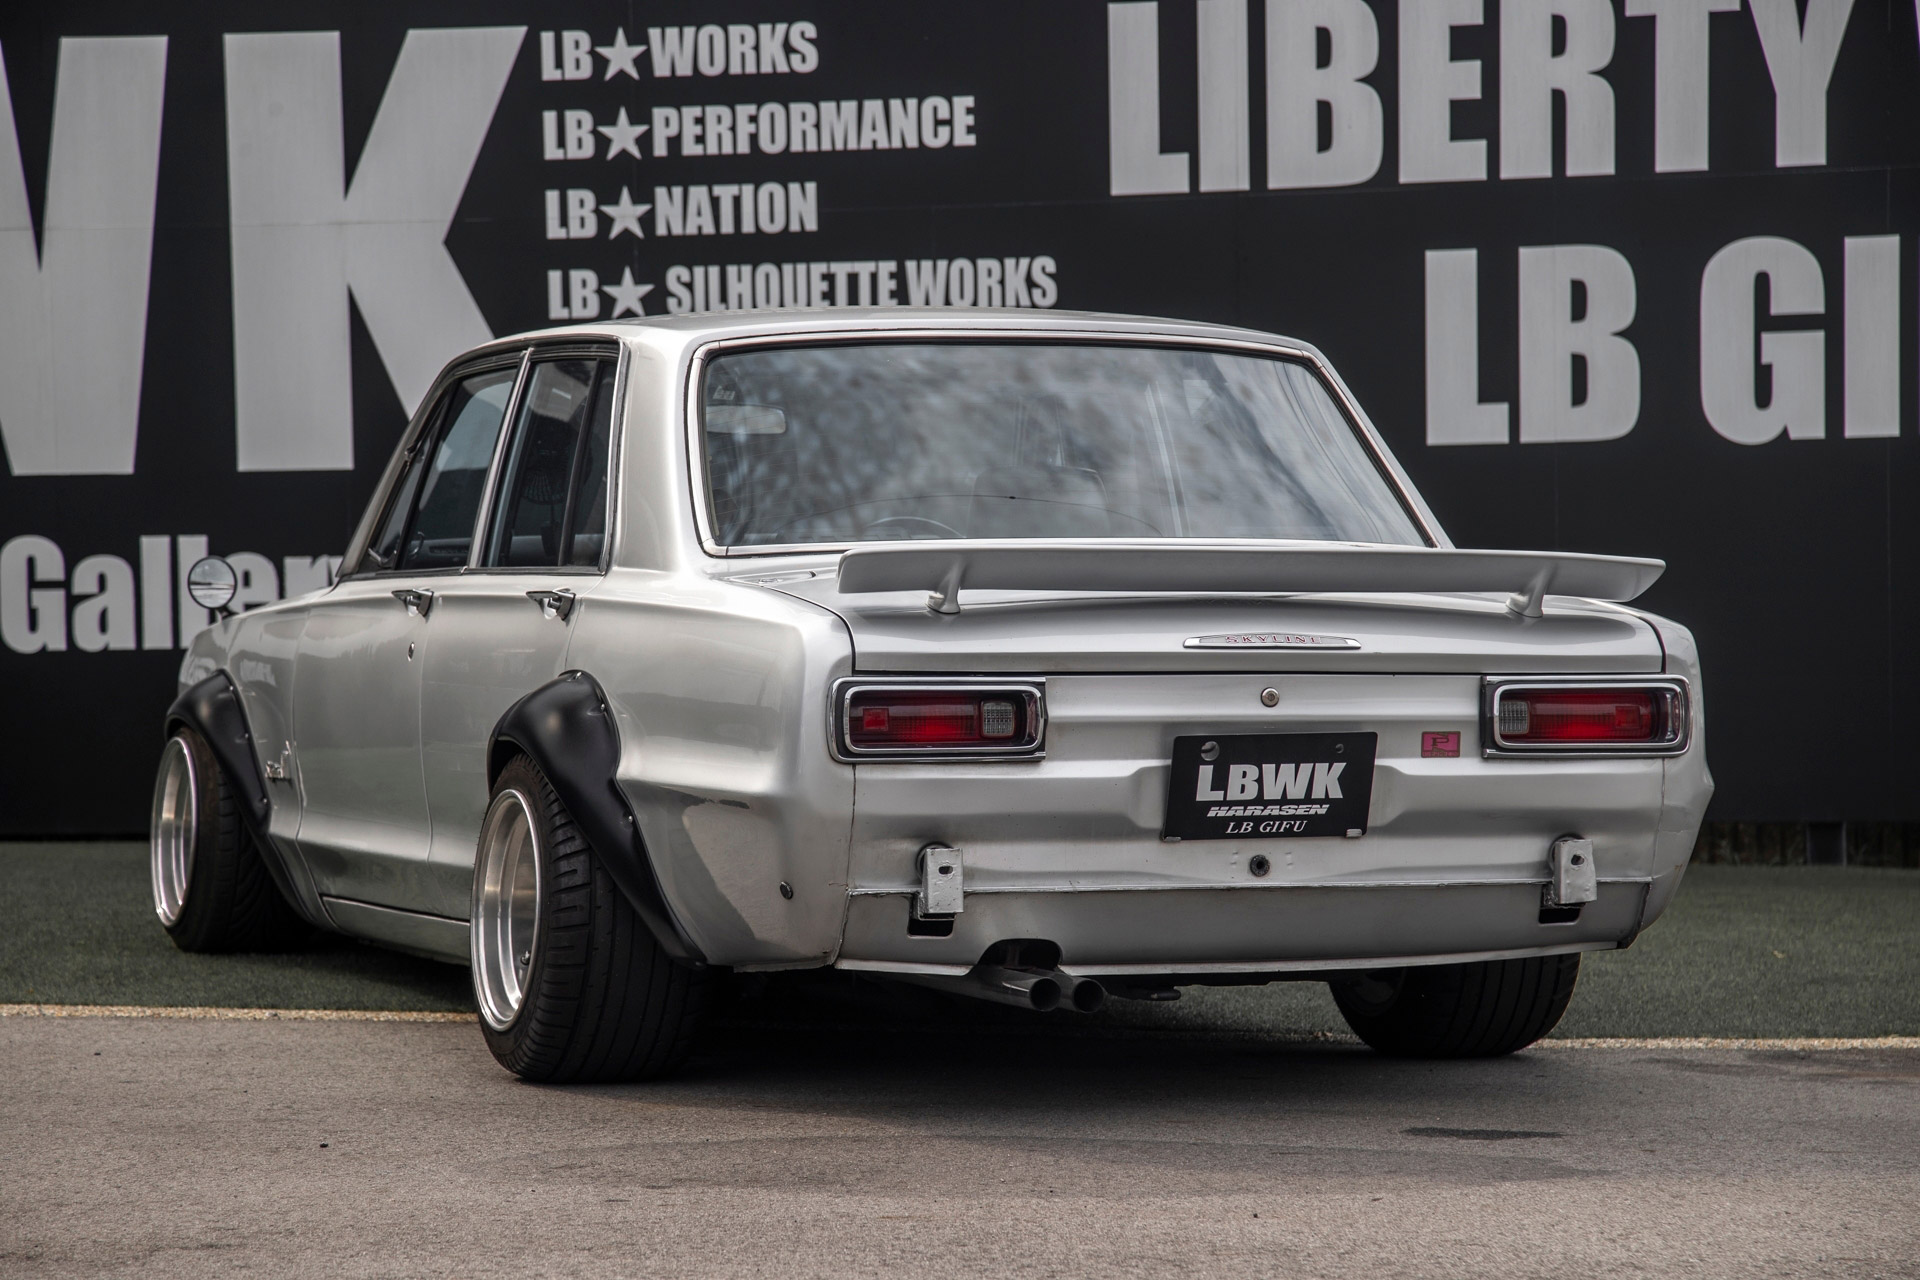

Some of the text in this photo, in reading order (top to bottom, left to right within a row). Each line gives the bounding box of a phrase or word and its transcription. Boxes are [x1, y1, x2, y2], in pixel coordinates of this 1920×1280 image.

[1107, 0, 1853, 196] LIBERTY
[547, 256, 1058, 320] LB SILHOUETTE WORKS
[1424, 244, 1641, 446] LB
[1225, 634, 1323, 645] SKYLINE
[1196, 762, 1347, 802] LBWK
[1206, 804, 1330, 818] HARASEN
[1226, 820, 1308, 834] LB GIFU
